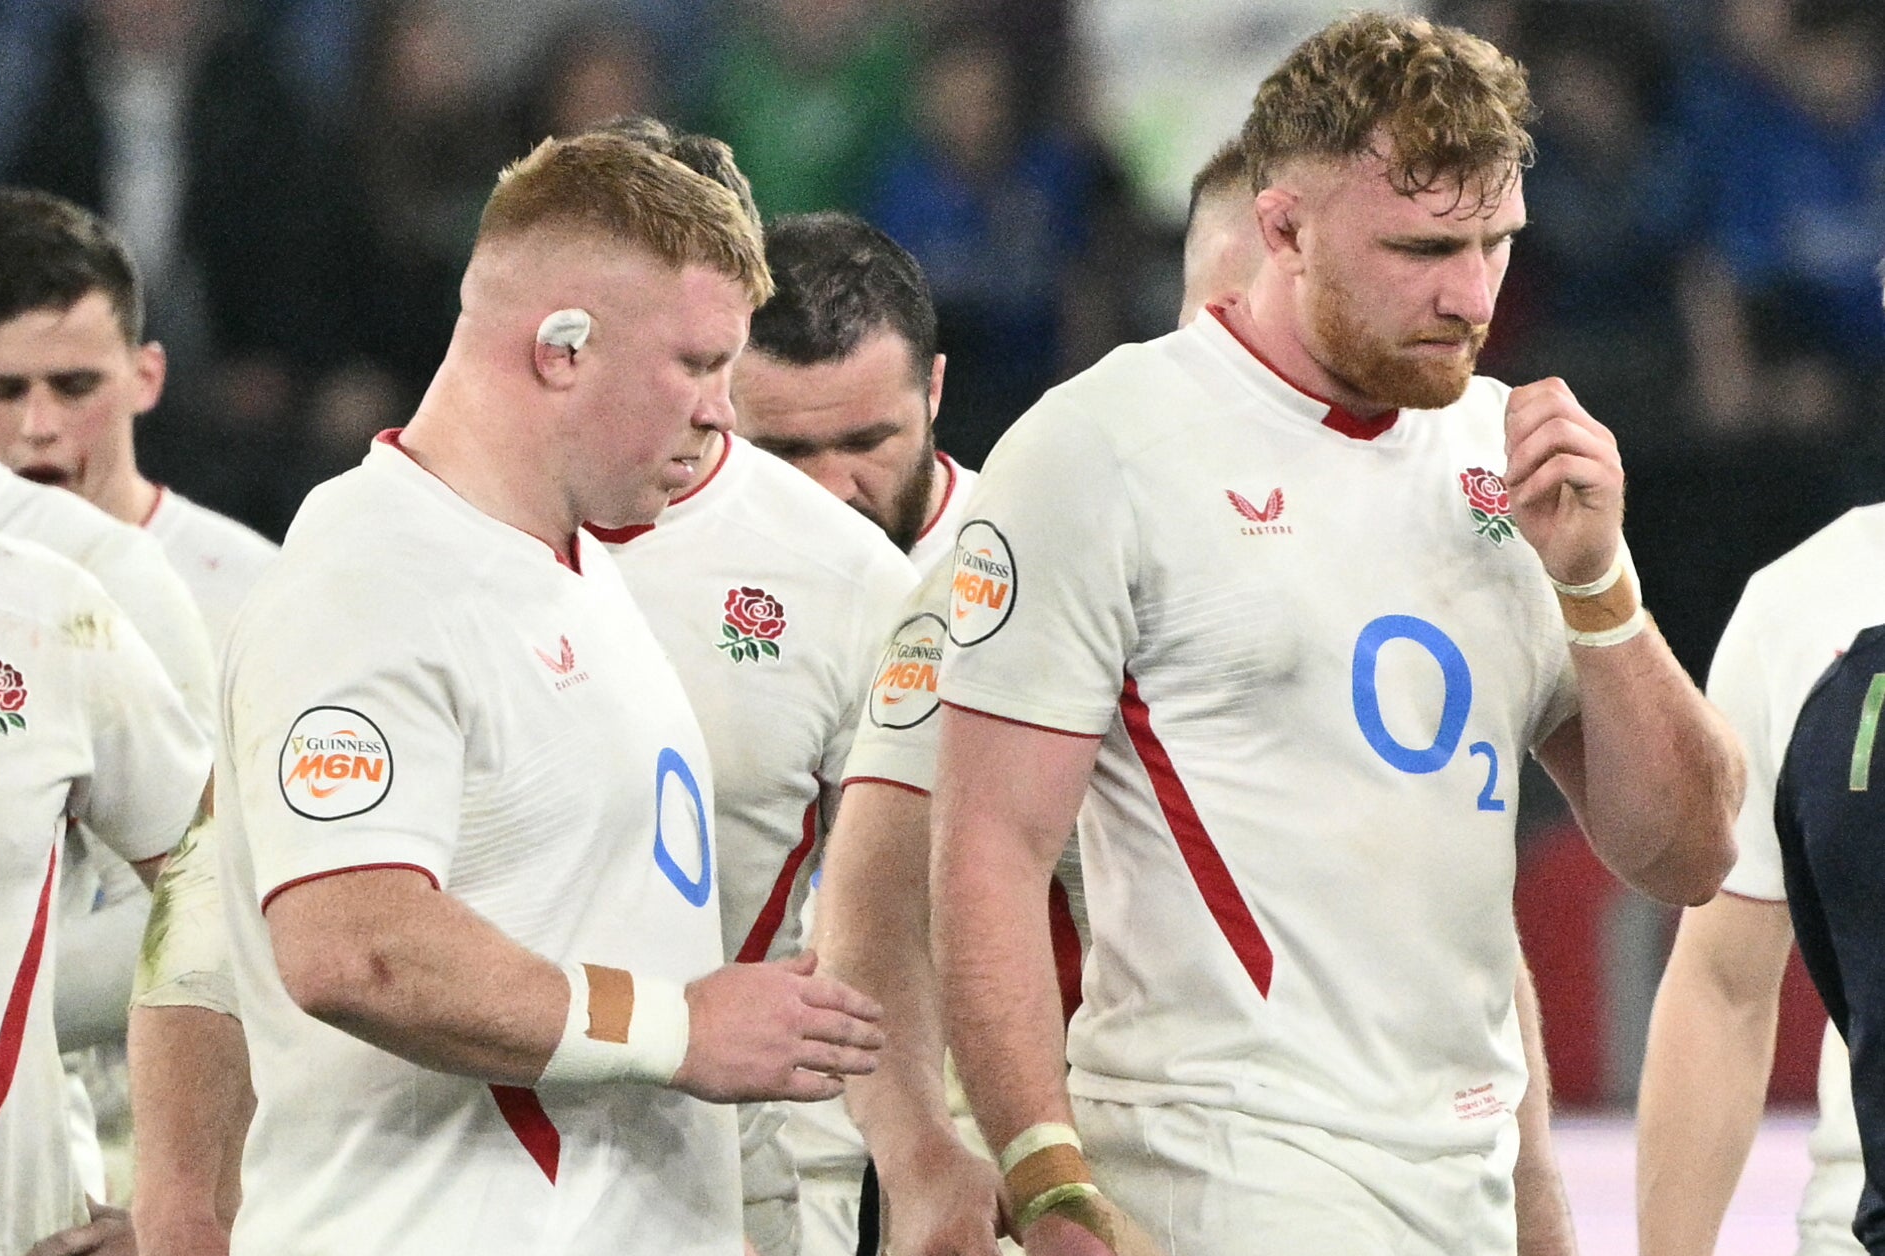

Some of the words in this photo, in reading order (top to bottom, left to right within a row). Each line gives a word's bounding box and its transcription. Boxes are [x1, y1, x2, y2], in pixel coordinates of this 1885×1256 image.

[963, 551, 1011, 578] GUINNESS
[898, 644, 943, 661] GUINNES
[306, 737, 382, 754] GUINNESS
